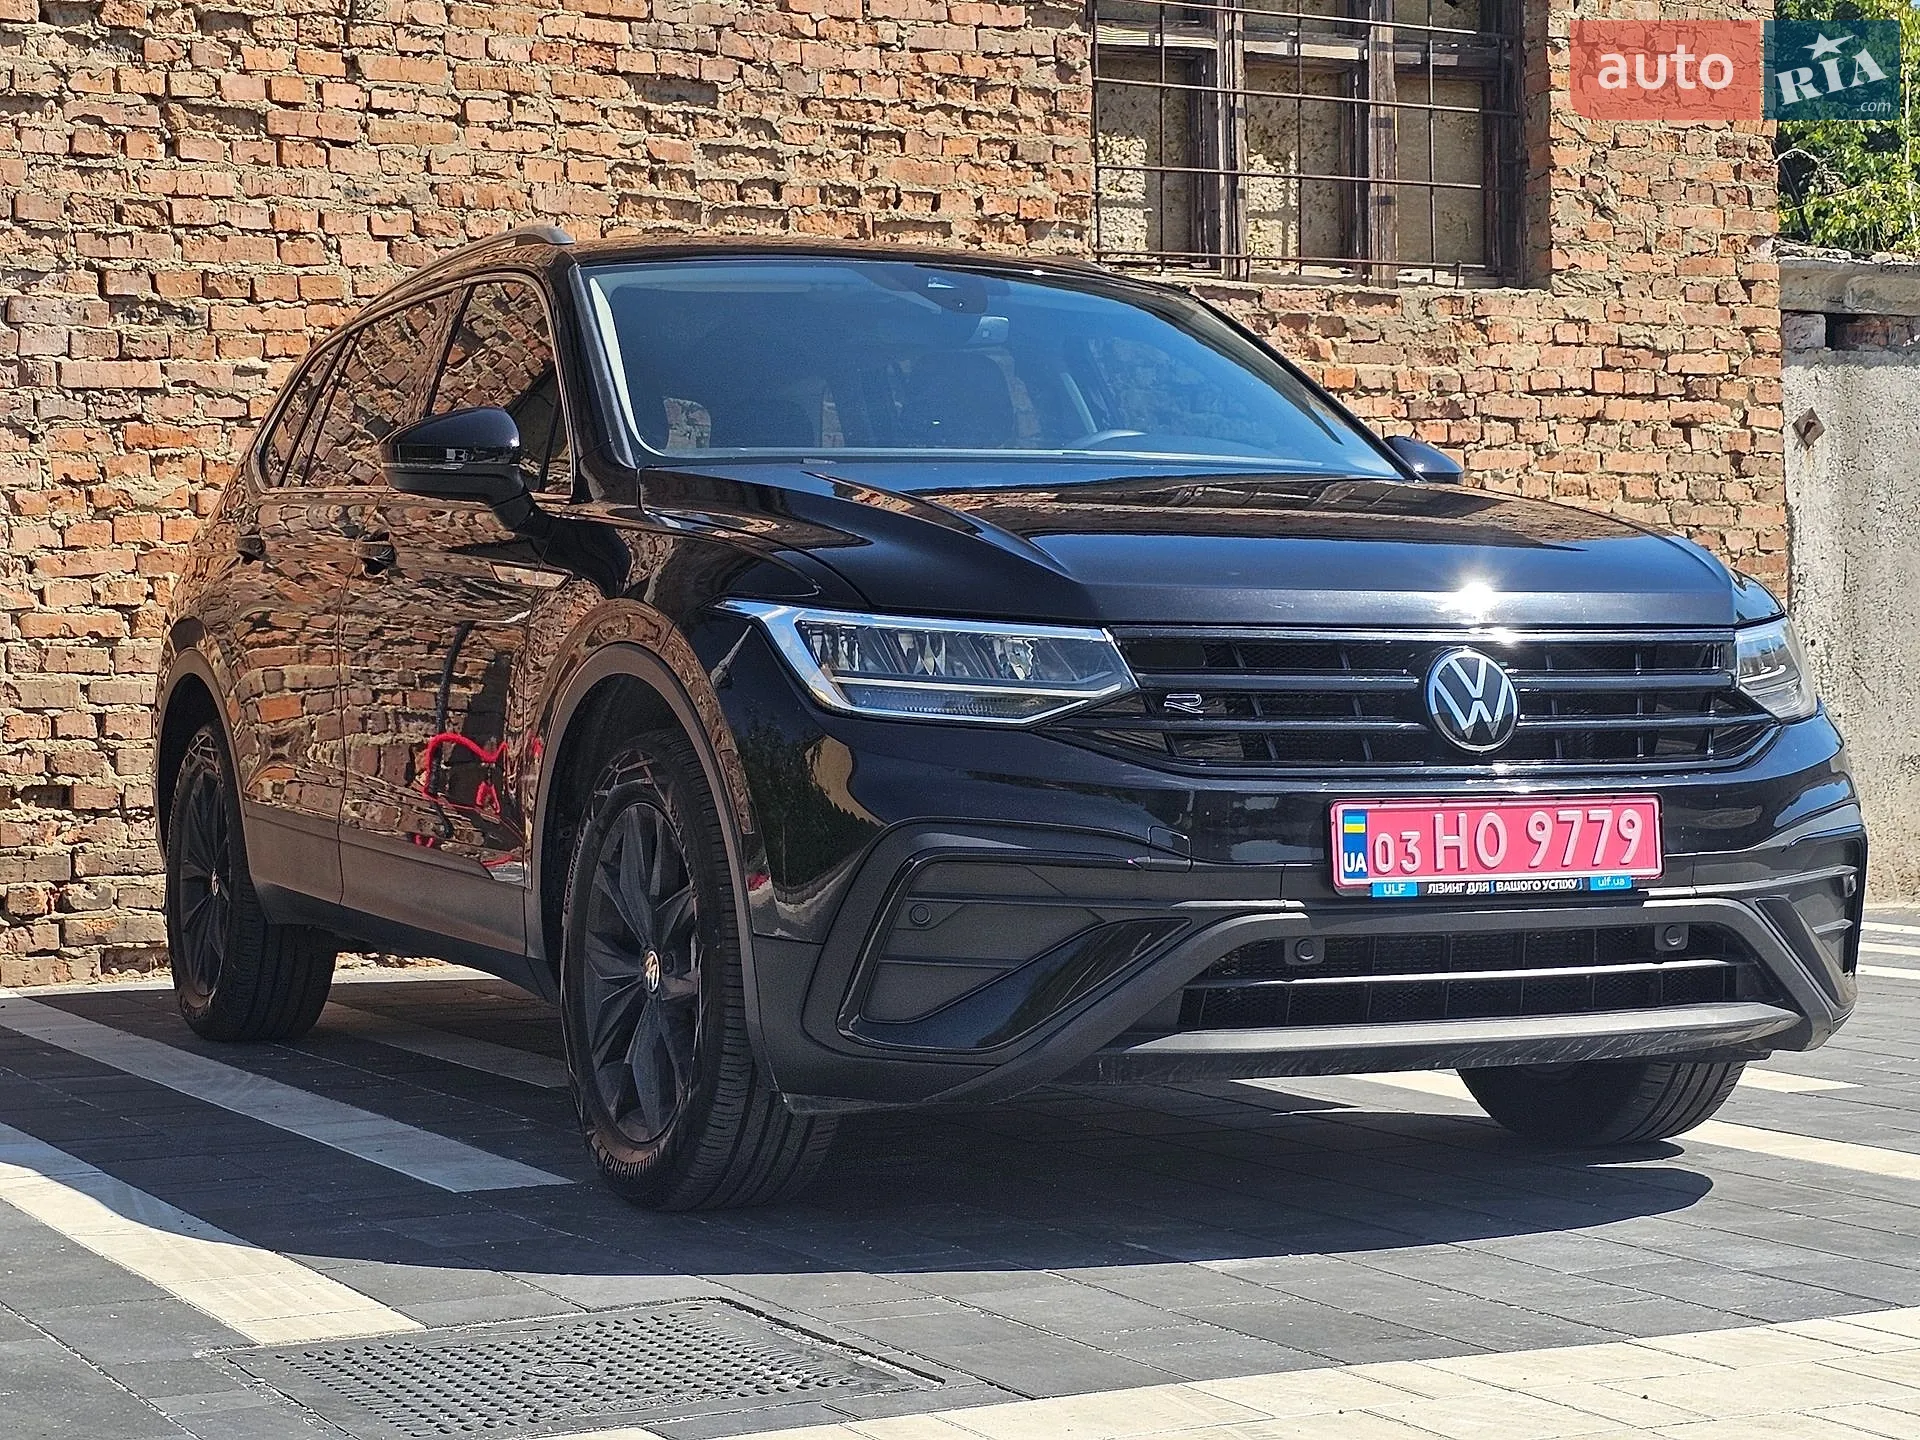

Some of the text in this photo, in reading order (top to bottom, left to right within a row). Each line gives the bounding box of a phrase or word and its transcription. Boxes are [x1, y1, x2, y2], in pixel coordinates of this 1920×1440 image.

[1373, 831, 1421, 875] 03
[1525, 808, 1644, 868] 9779
[1343, 852, 1367, 873] UA
[1383, 882, 1407, 896] ULF
[1466, 880, 1490, 896] ДЛЯ
[1597, 876, 1625, 887] ulf.ua
